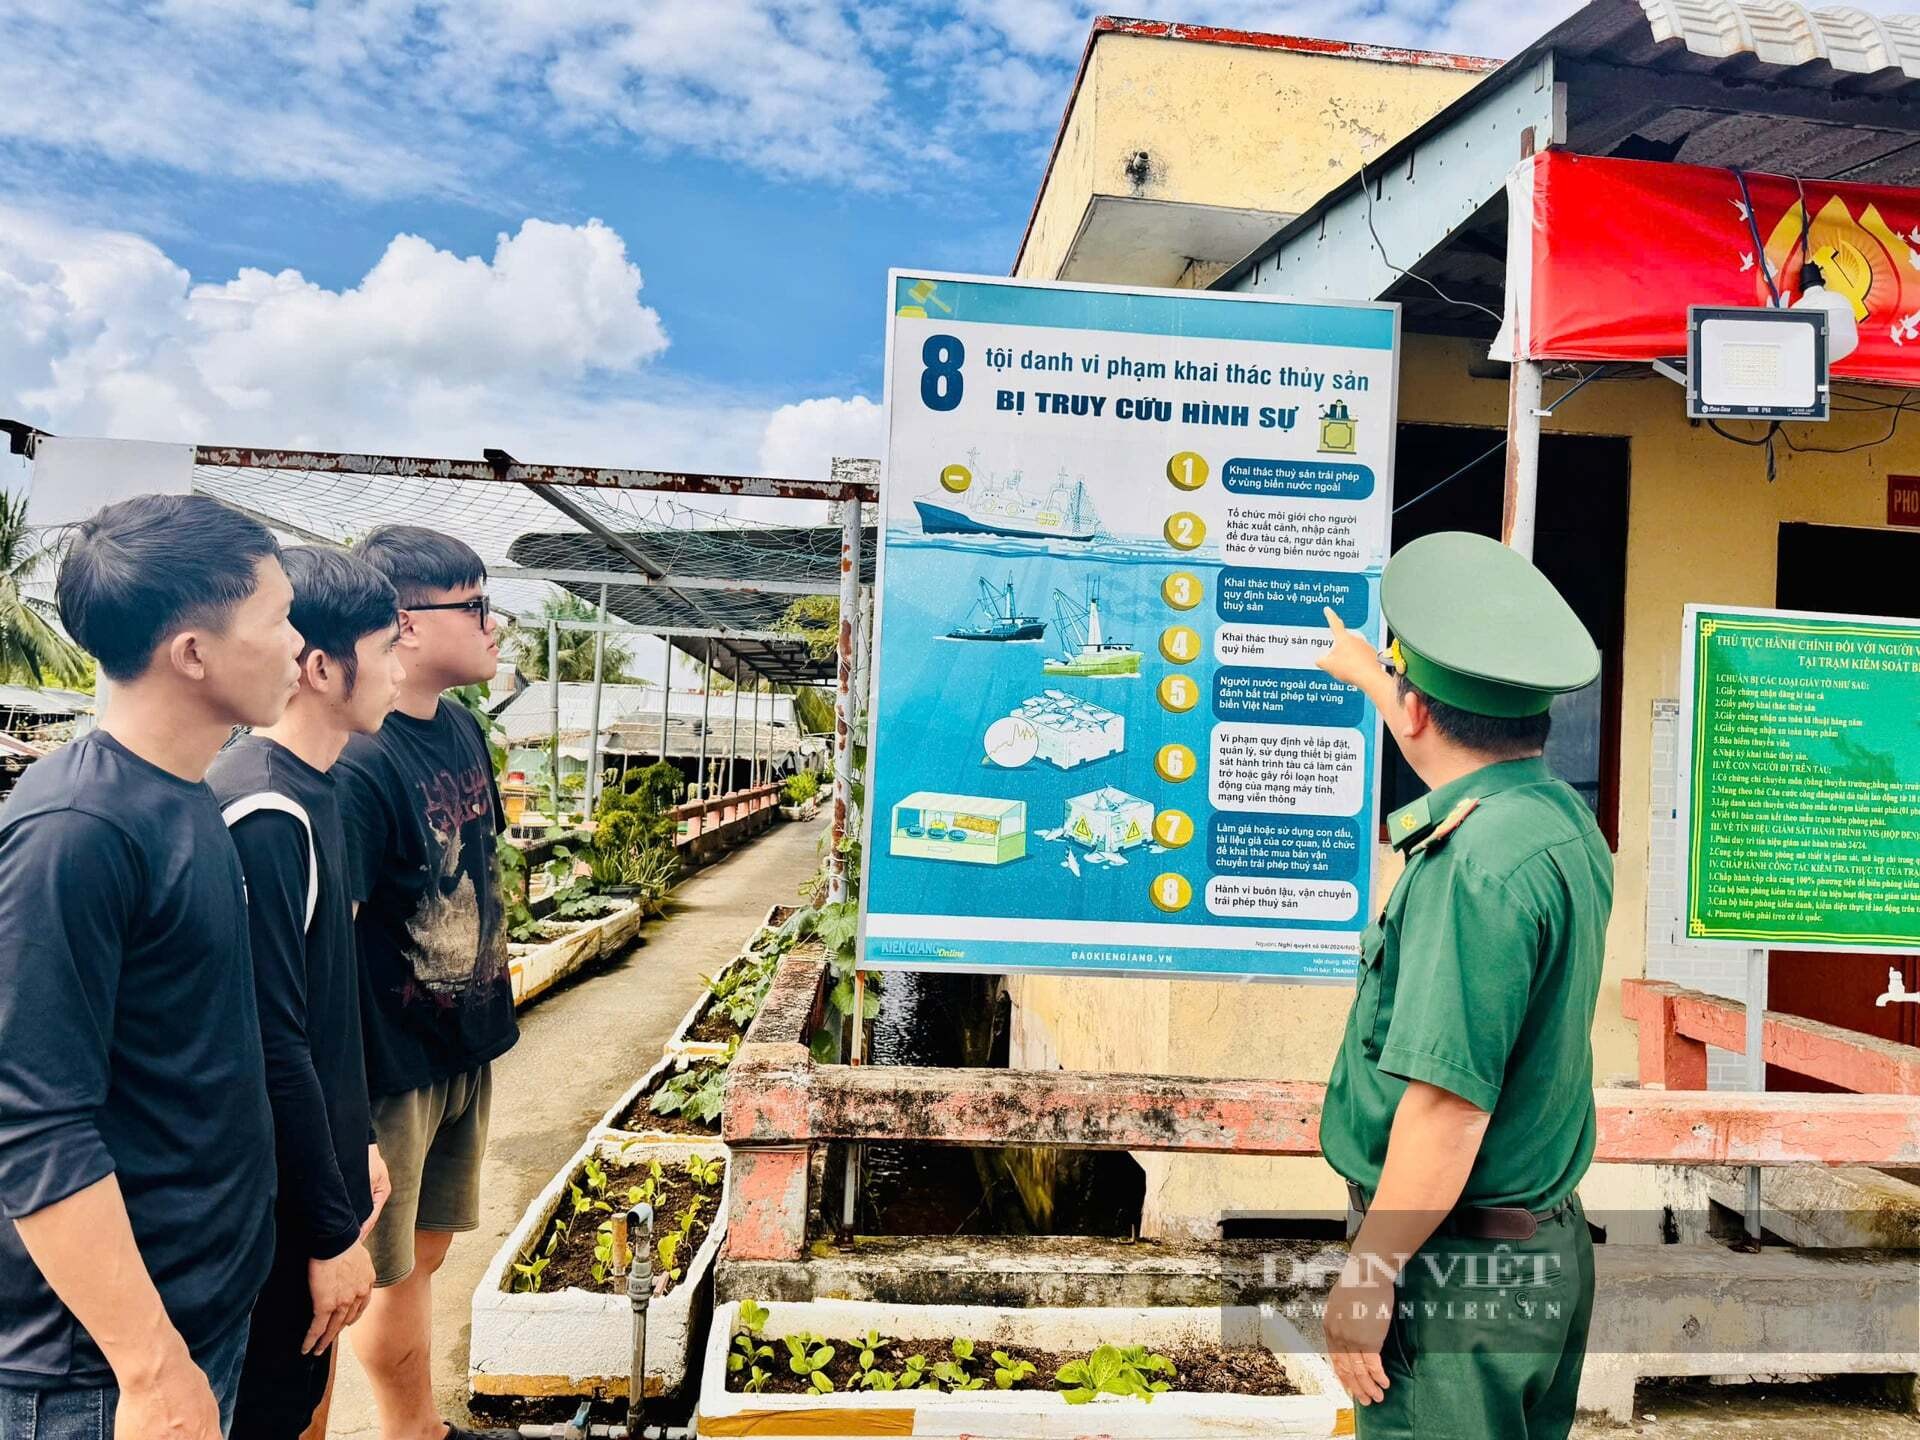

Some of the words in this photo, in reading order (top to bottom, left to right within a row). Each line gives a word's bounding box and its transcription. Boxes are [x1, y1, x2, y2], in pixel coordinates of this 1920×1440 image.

[920, 333, 965, 412] 8
[985, 348, 1012, 371] tội
[1020, 350, 1073, 371] danh
[1080, 354, 1099, 373] vi
[1107, 357, 1166, 381] phạm
[1174, 360, 1218, 381] khai
[1225, 364, 1271, 384] thác
[1279, 367, 1325, 391] thủy
[1332, 370, 1368, 390] sản
[996, 390, 1025, 414] BỊ
[1034, 393, 1106, 416] TRUY
[1115, 397, 1172, 421] CỨU
[1181, 402, 1249, 426] HÌNH
[1258, 407, 1299, 432] SỰ
[1182, 458, 1193, 484] 1
[1229, 466, 1250, 475] Khai
[1252, 467, 1273, 476] thác
[1317, 470, 1333, 479] trái
[1335, 471, 1359, 482] phép
[1286, 481, 1311, 489] nước
[1314, 483, 1340, 492] ngoài
[1241, 510, 1266, 518] chức
[1267, 511, 1285, 520] môi
[1287, 512, 1306, 522] giới
[1308, 513, 1326, 522] cho
[1328, 516, 1357, 524] người
[1177, 518, 1193, 544] 2
[1226, 520, 1249, 531] khác
[1250, 522, 1271, 530] xuất
[1301, 525, 1325, 534] nhập
[1326, 526, 1350, 534] cảnh
[1239, 533, 1258, 541] đưa
[1260, 534, 1276, 542] tàu
[1294, 537, 1314, 546] ngư
[1315, 537, 1333, 545] dân
[1334, 538, 1355, 546] khai
[1226, 544, 1245, 552] thác
[1333, 551, 1358, 559] ngoài
[1174, 577, 1190, 604] 3
[1224, 578, 1246, 586] Khai
[1247, 579, 1268, 588] thác
[1311, 582, 1321, 593] vi
[1322, 584, 1349, 593] phạm
[1223, 591, 1242, 600] quy
[1243, 591, 1264, 600] định
[1286, 593, 1298, 603] vệ
[1331, 595, 1344, 605] lợi
[1171, 631, 1188, 658] 4
[1222, 632, 1243, 641] Khai
[1245, 634, 1266, 642] thác
[1310, 639, 1334, 648] nguy
[1221, 646, 1239, 654] quý
[1220, 676, 1250, 687] Người
[1252, 678, 1278, 687] nước
[1280, 680, 1306, 690] ngoài
[1308, 681, 1328, 690] đưa
[1329, 682, 1344, 690] tàu
[1170, 680, 1186, 706] 5
[1219, 688, 1243, 700] đánh
[1262, 690, 1278, 699] trái
[1280, 691, 1304, 702] phép
[1305, 692, 1318, 702] tại
[1242, 701, 1260, 711] Việt
[1262, 702, 1283, 710] Nam
[1220, 733, 1229, 742] Vi
[1231, 735, 1258, 744] phạm
[1260, 737, 1278, 746] quy
[1280, 737, 1301, 746] định
[1332, 739, 1350, 749] đặt,
[1167, 750, 1183, 776] 6
[1218, 781, 1242, 791] động
[1264, 784, 1290, 793] mạng
[1292, 785, 1312, 794] máy
[1314, 786, 1335, 794] tính,
[1217, 794, 1244, 803] mạng
[1268, 795, 1296, 805] thông
[1165, 815, 1181, 843] 7
[1249, 859, 1264, 867] trái
[1266, 860, 1289, 870] phép
[1162, 878, 1179, 905] 8
[1214, 884, 1239, 893] Hành
[1241, 886, 1250, 894] vi
[1252, 886, 1276, 895] buôn
[1278, 887, 1296, 897] lậu,
[1298, 888, 1315, 896] vận
[1232, 897, 1256, 907] phép
